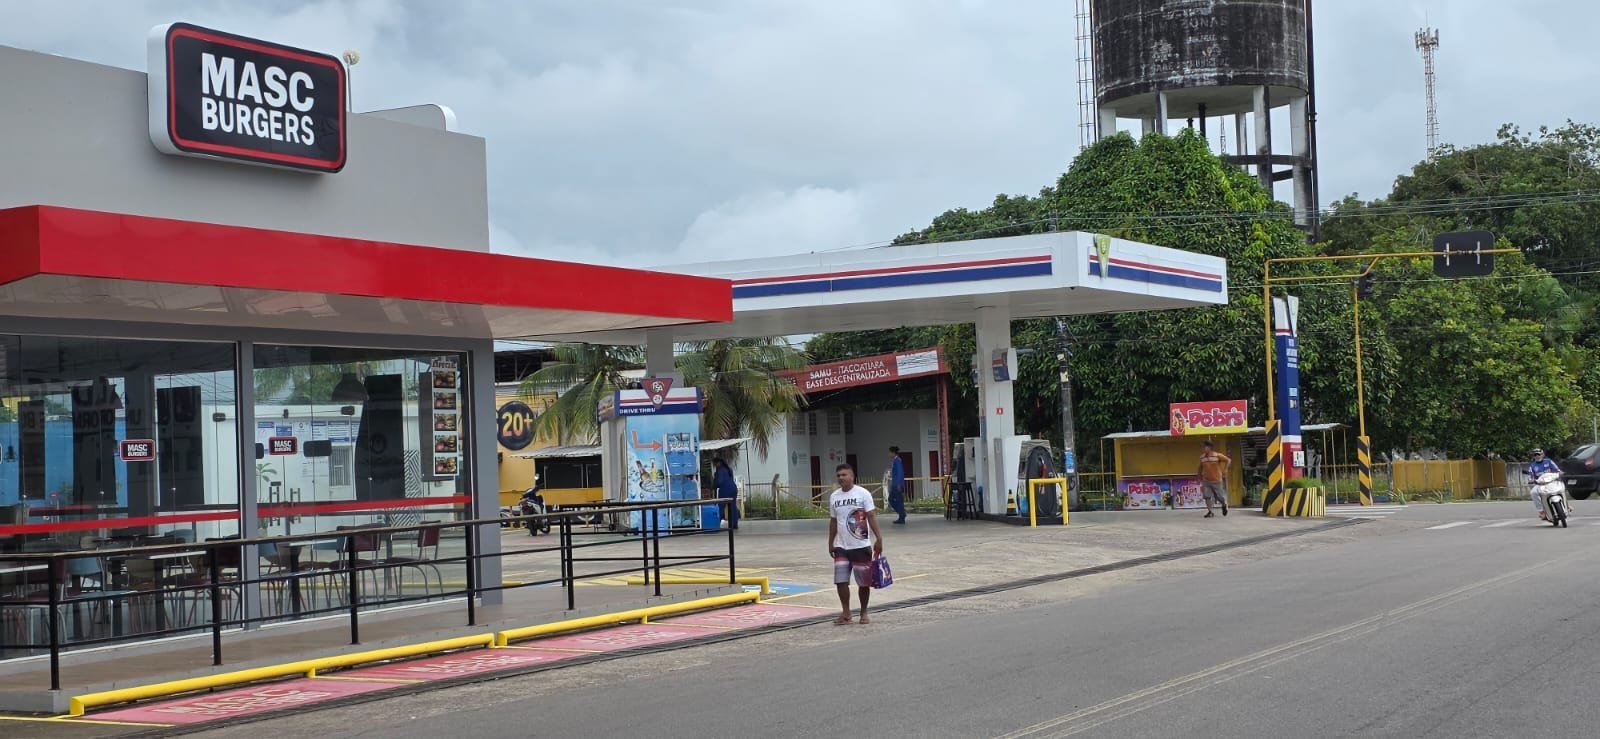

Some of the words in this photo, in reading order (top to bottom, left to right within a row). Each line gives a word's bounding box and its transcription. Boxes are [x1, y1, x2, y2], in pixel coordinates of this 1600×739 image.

[202, 52, 314, 112] MASC
[202, 97, 315, 146] BURGERS
[806, 378, 824, 389] BASE
[824, 369, 890, 387] DESCENTRALIZADA
[810, 369, 832, 380] SAMU
[839, 361, 885, 375] ITACOATIARA
[502, 411, 533, 437] 20+
[128, 443, 148, 452] MASC
[274, 440, 292, 448] MASC
